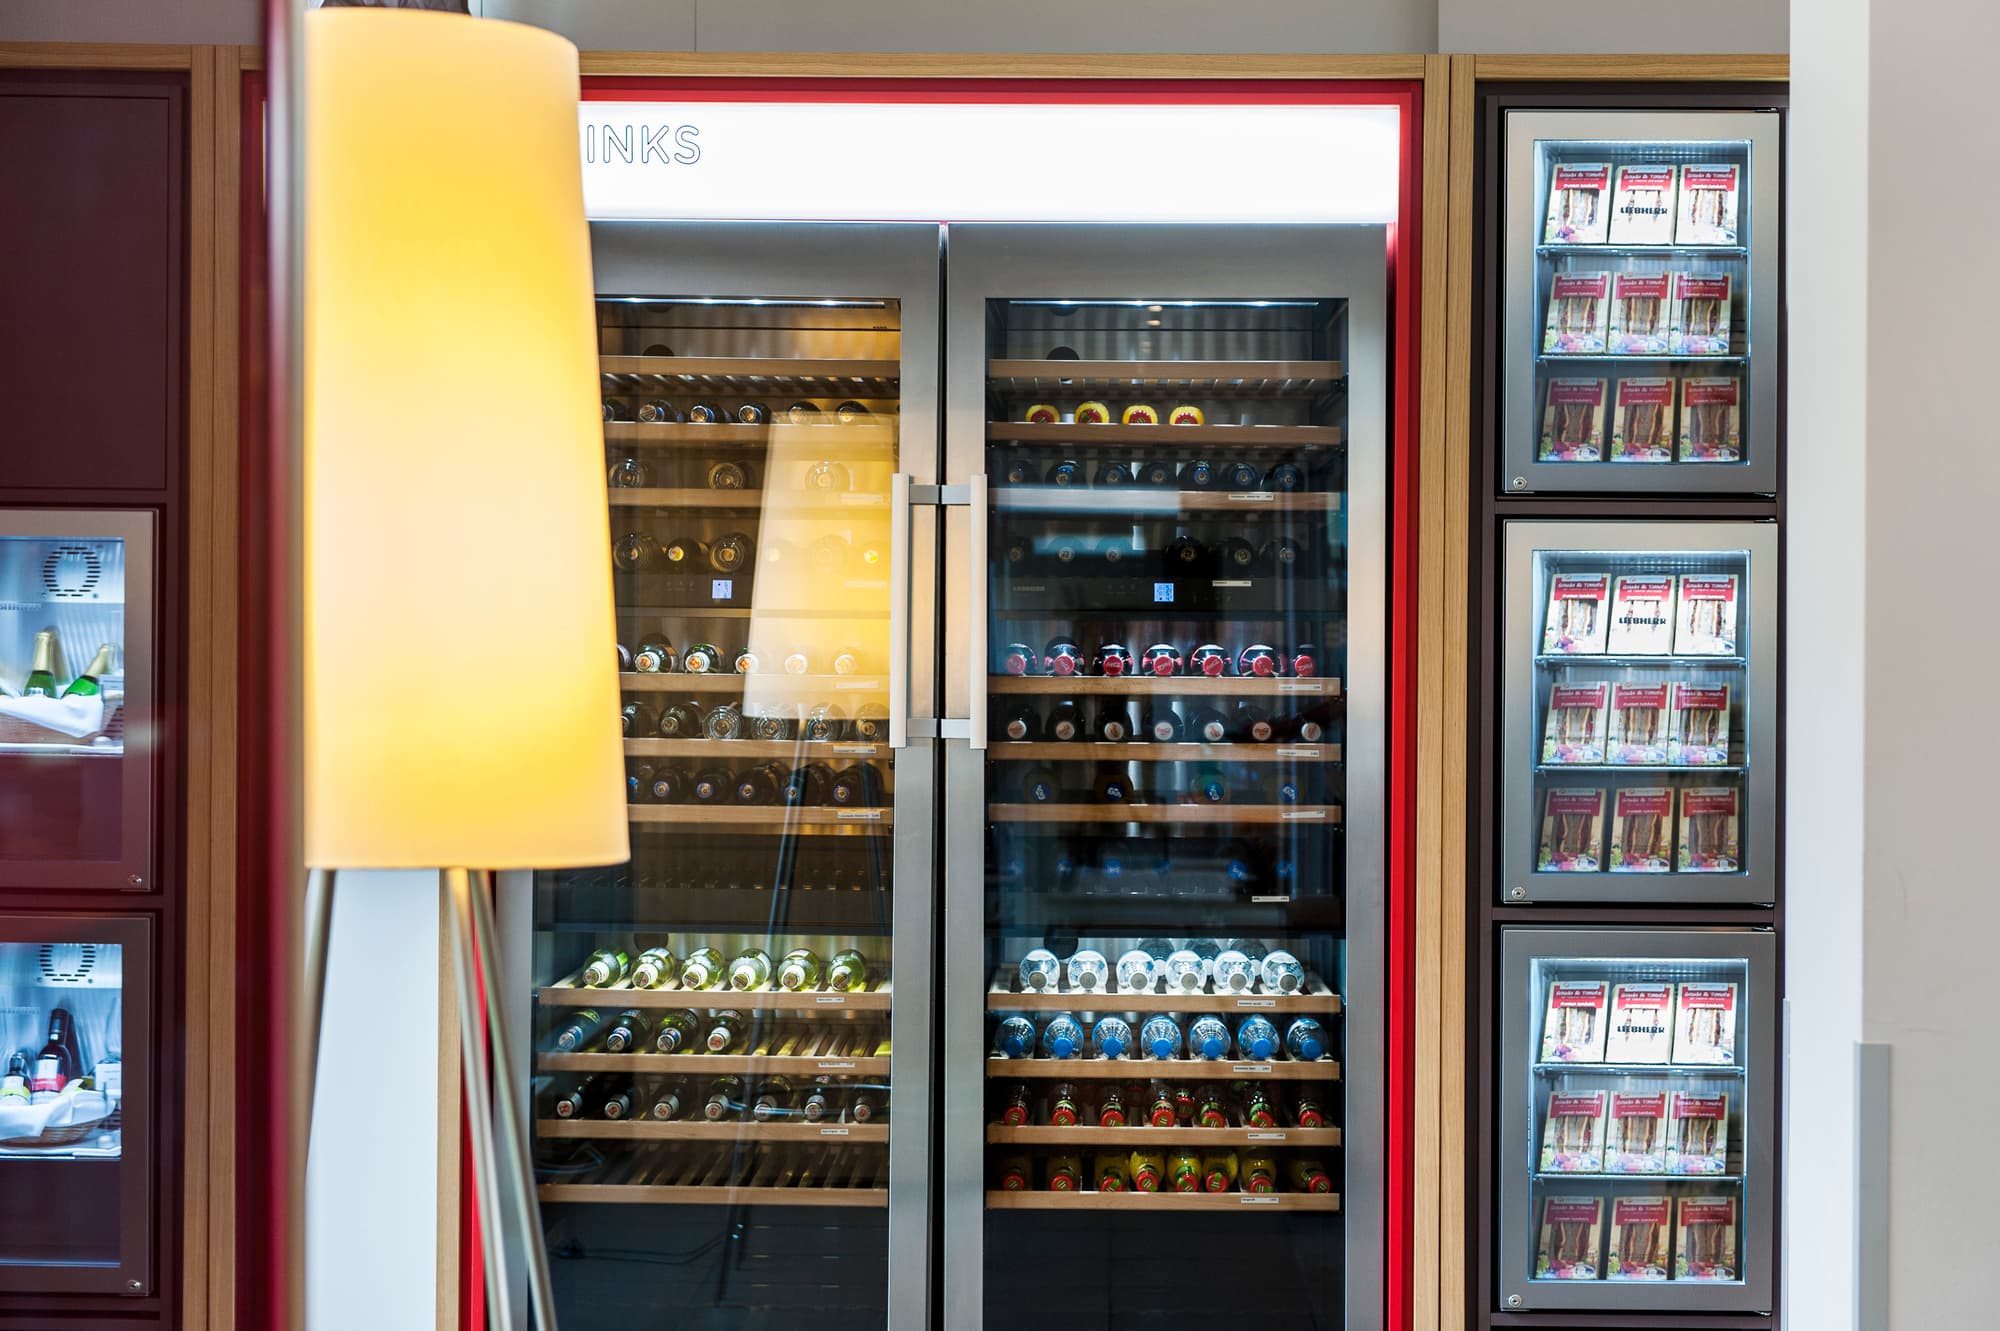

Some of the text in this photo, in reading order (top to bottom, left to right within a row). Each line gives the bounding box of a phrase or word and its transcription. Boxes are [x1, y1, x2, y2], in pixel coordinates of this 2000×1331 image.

[1620, 206, 1668, 215] LIEBHERR
[1619, 616, 1666, 625] LIEBHERR
[1617, 1025, 1665, 1034] LIEBHERR
